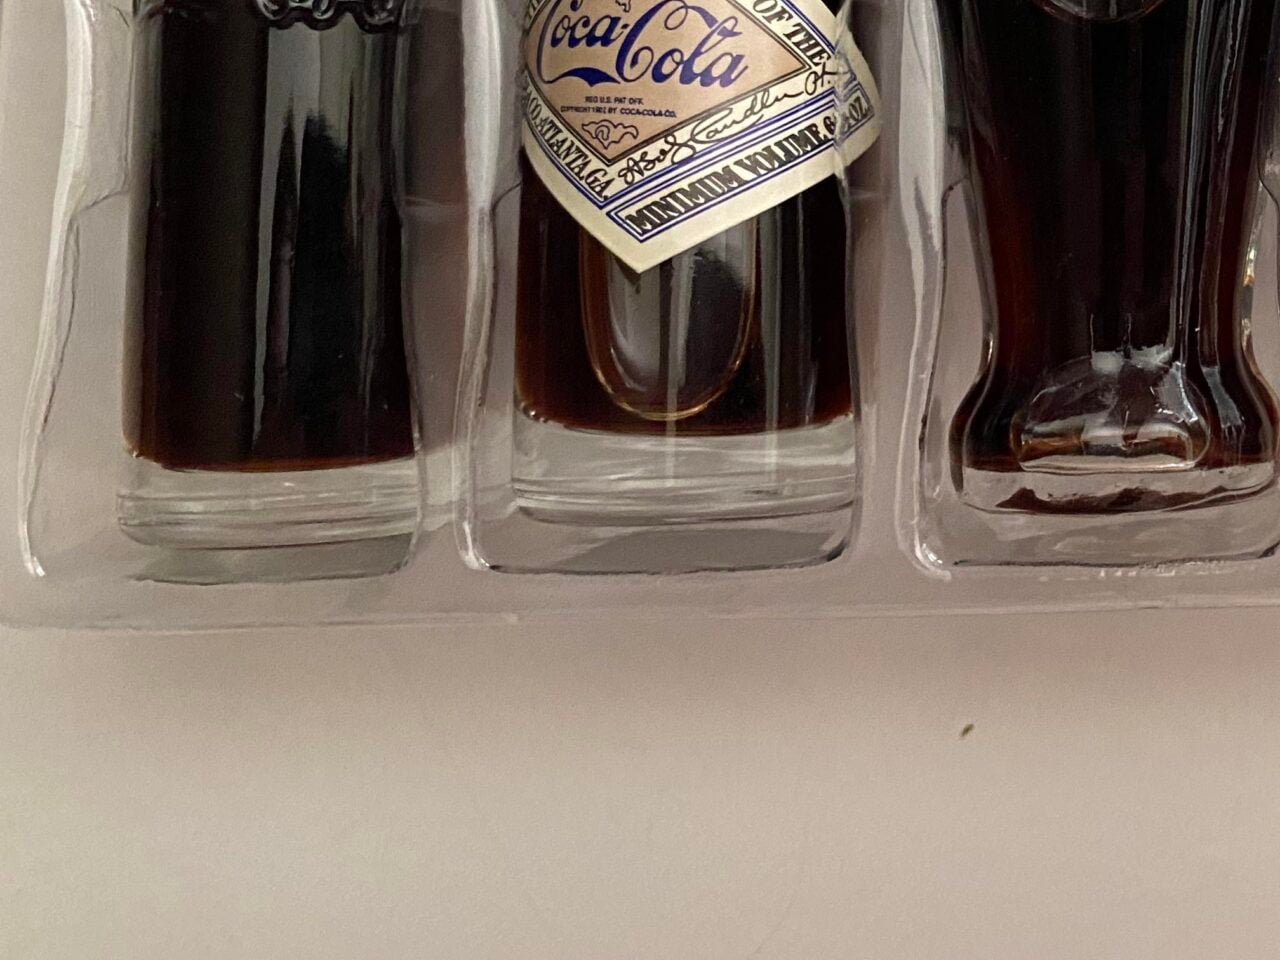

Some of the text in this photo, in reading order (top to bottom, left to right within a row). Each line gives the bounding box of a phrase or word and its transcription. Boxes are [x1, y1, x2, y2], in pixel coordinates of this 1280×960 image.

[782, 21, 832, 67] THE
[624, 164, 746, 234] MINIMUM
[733, 122, 826, 178] VOLUME
